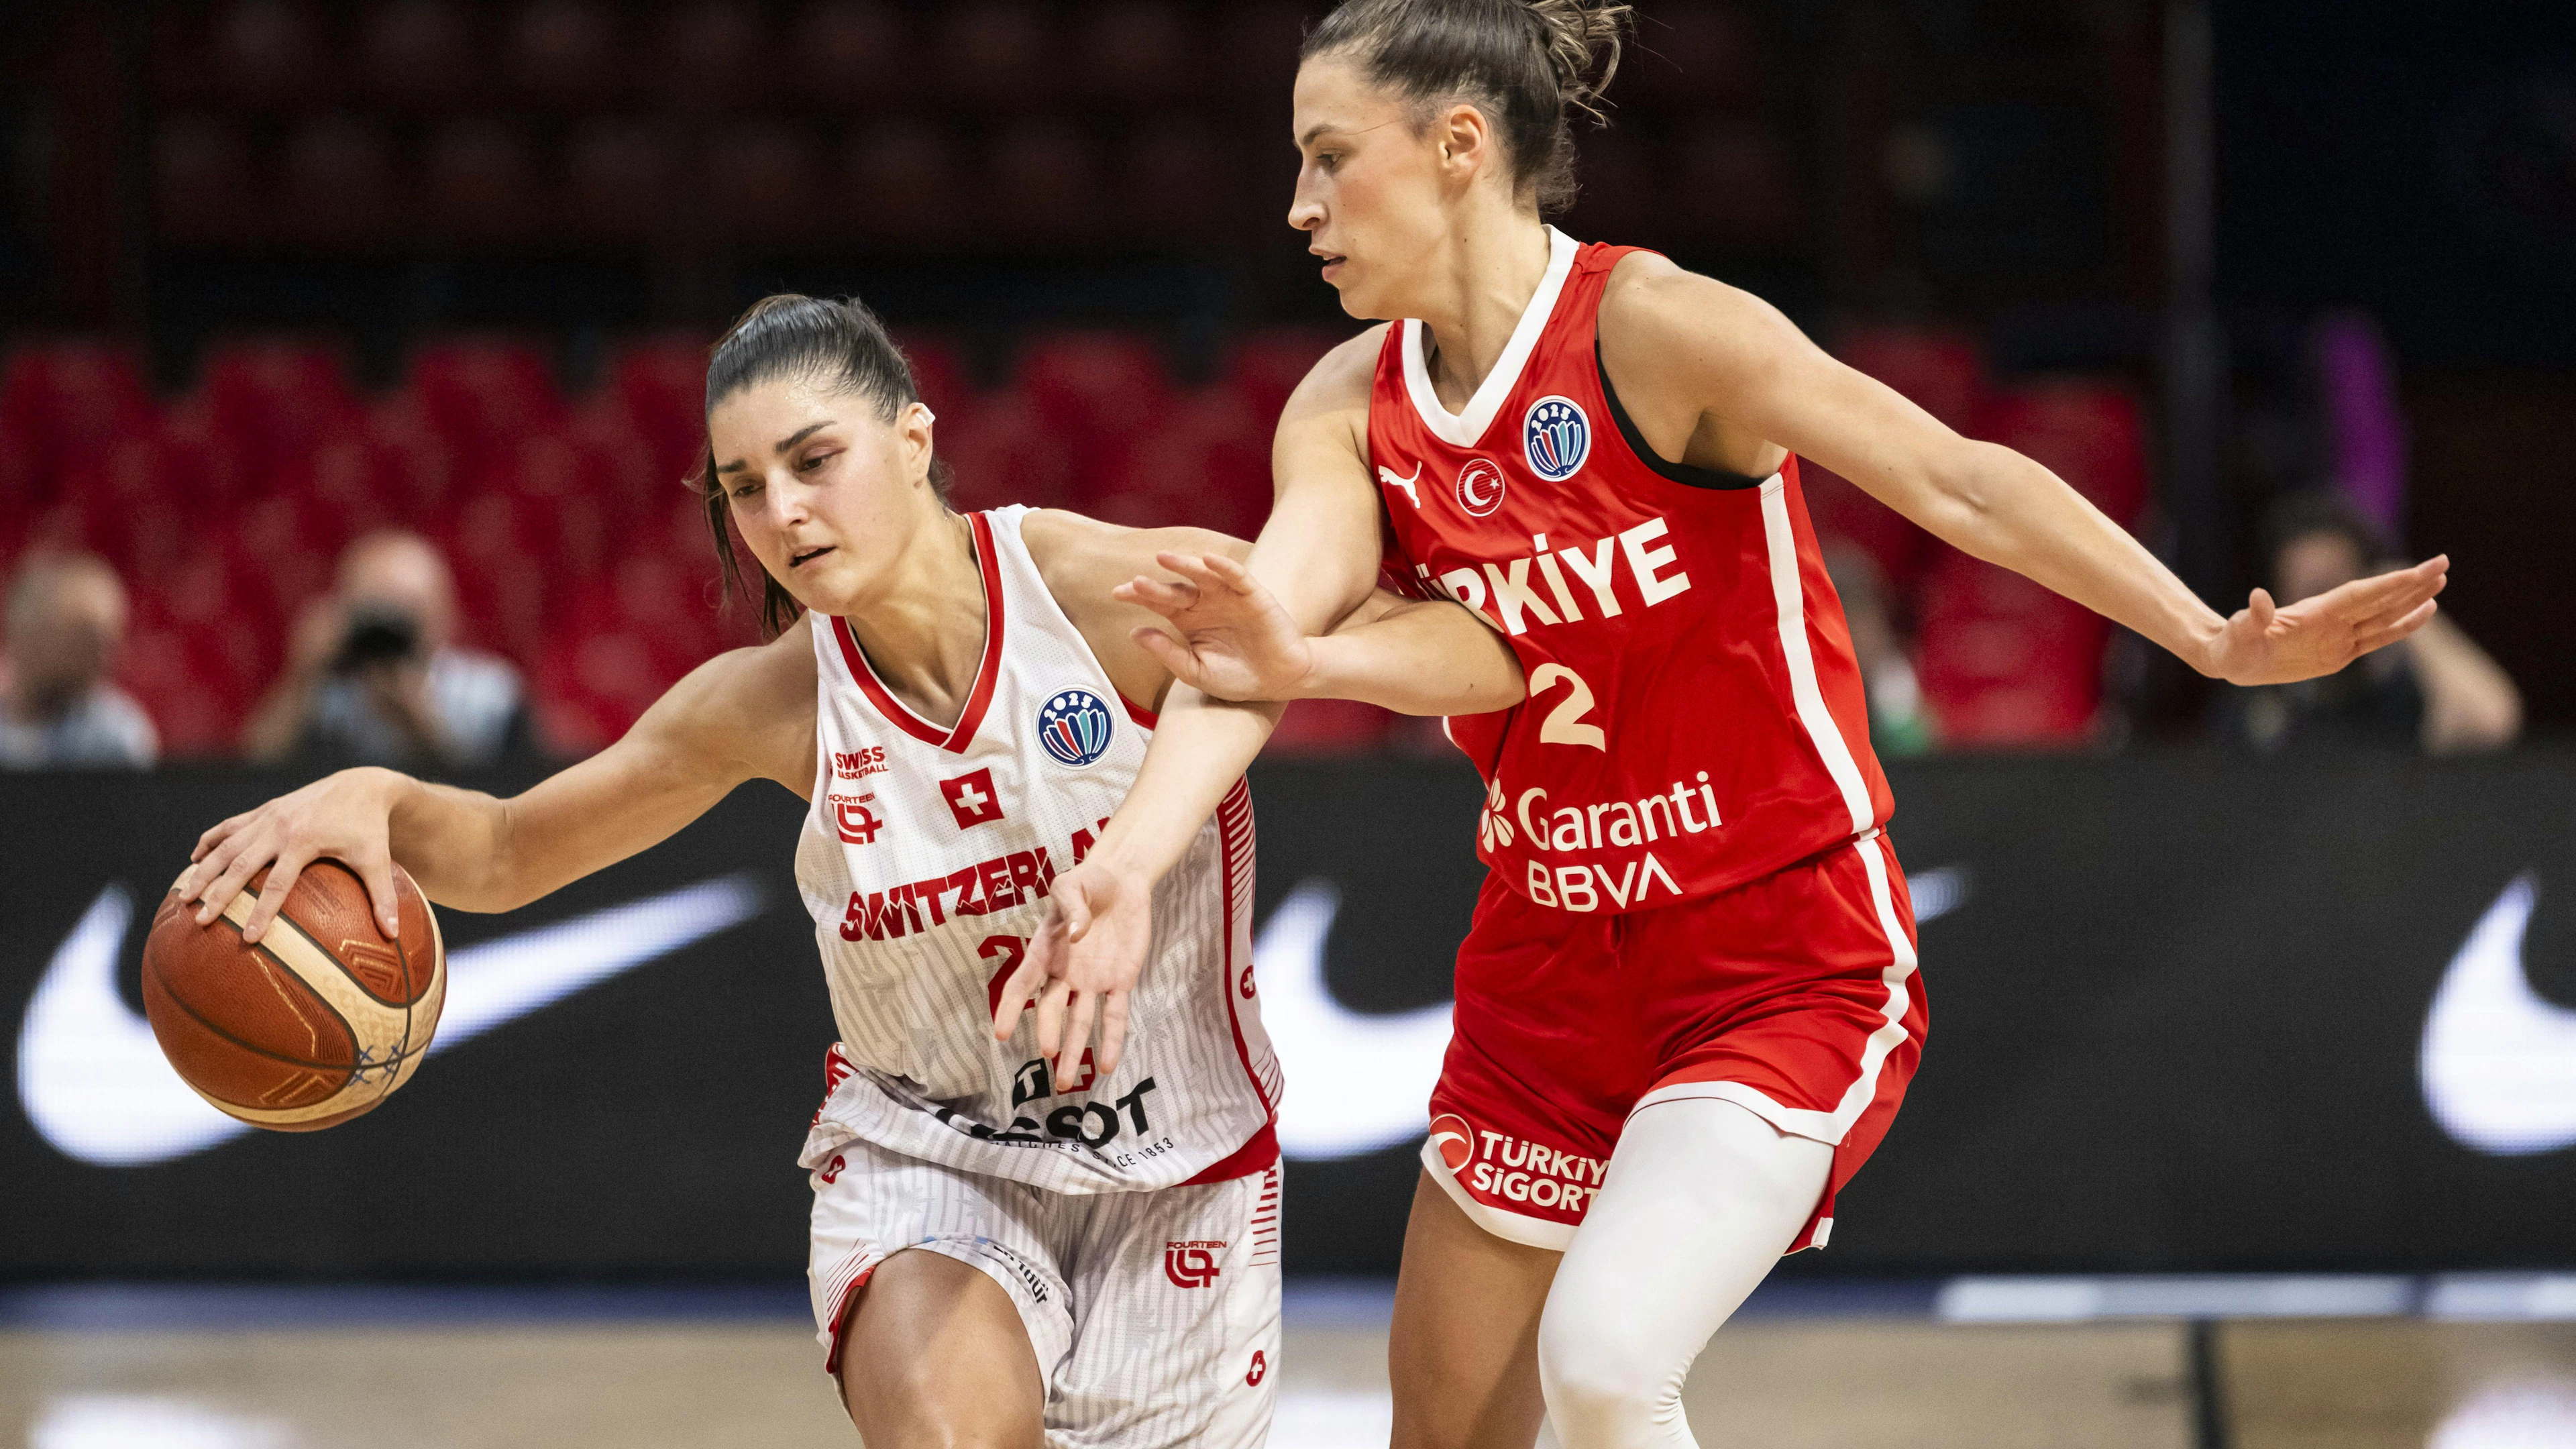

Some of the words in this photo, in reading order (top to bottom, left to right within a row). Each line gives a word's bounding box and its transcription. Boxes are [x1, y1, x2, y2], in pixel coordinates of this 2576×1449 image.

[1531, 404, 1571, 432] 2025
[1415, 517, 1692, 636] RKİYE
[1044, 692, 1093, 722] 2025
[1529, 663, 1606, 753] 2
[835, 746, 885, 770] SWISS
[837, 763, 889, 780] BASKETBALL
[828, 792, 875, 804] FOURTEEN
[1517, 771, 1723, 852] Garanti
[1528, 851, 1683, 912] BBVA
[1092, 1151, 1136, 1167] SCE
[1138, 1136, 1174, 1160] 1853
[1481, 1130, 1611, 1185] TÜRKİY
[1471, 1162, 1601, 1212] SİGORT
[1166, 1240, 1227, 1249] FOURTEEN
